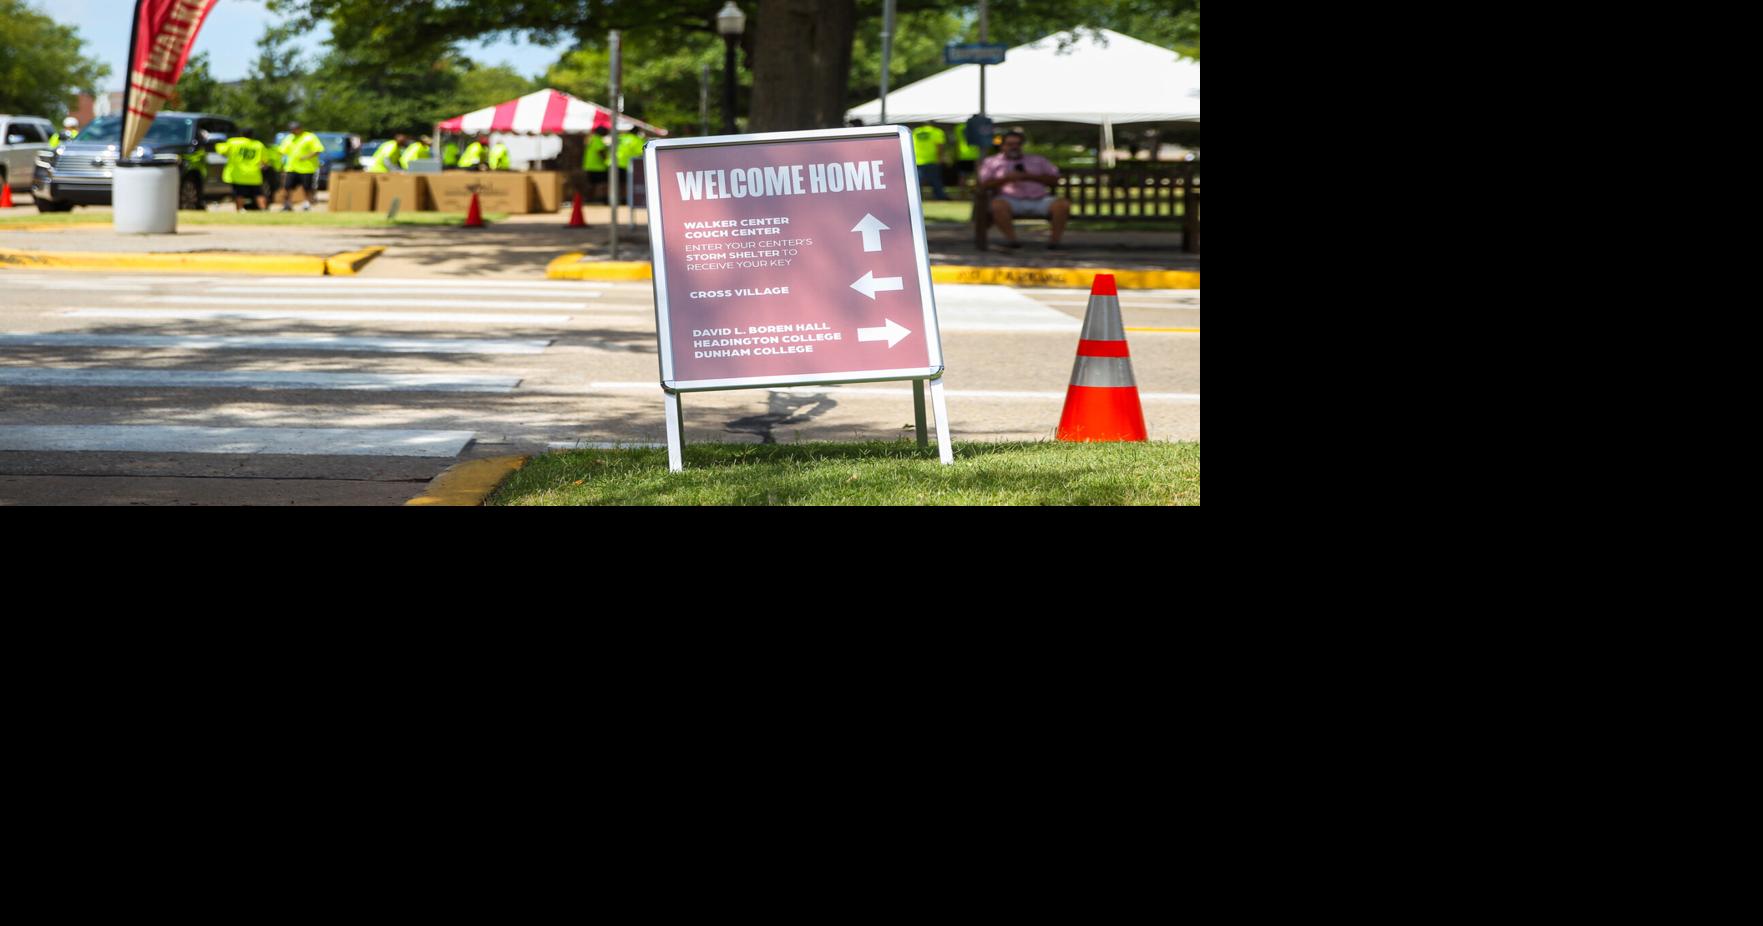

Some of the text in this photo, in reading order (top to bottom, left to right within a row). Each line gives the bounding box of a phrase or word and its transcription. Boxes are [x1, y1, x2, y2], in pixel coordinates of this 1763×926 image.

[676, 160, 886, 201] WELCOME HOME
[684, 217, 789, 229] WALKER CENTER
[685, 227, 780, 239] COUCH CENTER
[685, 238, 813, 252] ENTER YOUR CENTER'S
[686, 248, 798, 262] STORM SHELTER TO
[687, 258, 792, 271] RECEIVE YOUR KEY
[690, 286, 790, 299] CROSS VILLAGE
[692, 322, 831, 337] DAVID L. BOREN HALL
[693, 332, 842, 348] HEADINGTON COLLEGE
[694, 345, 814, 359] DUNHAM COLLEGE
